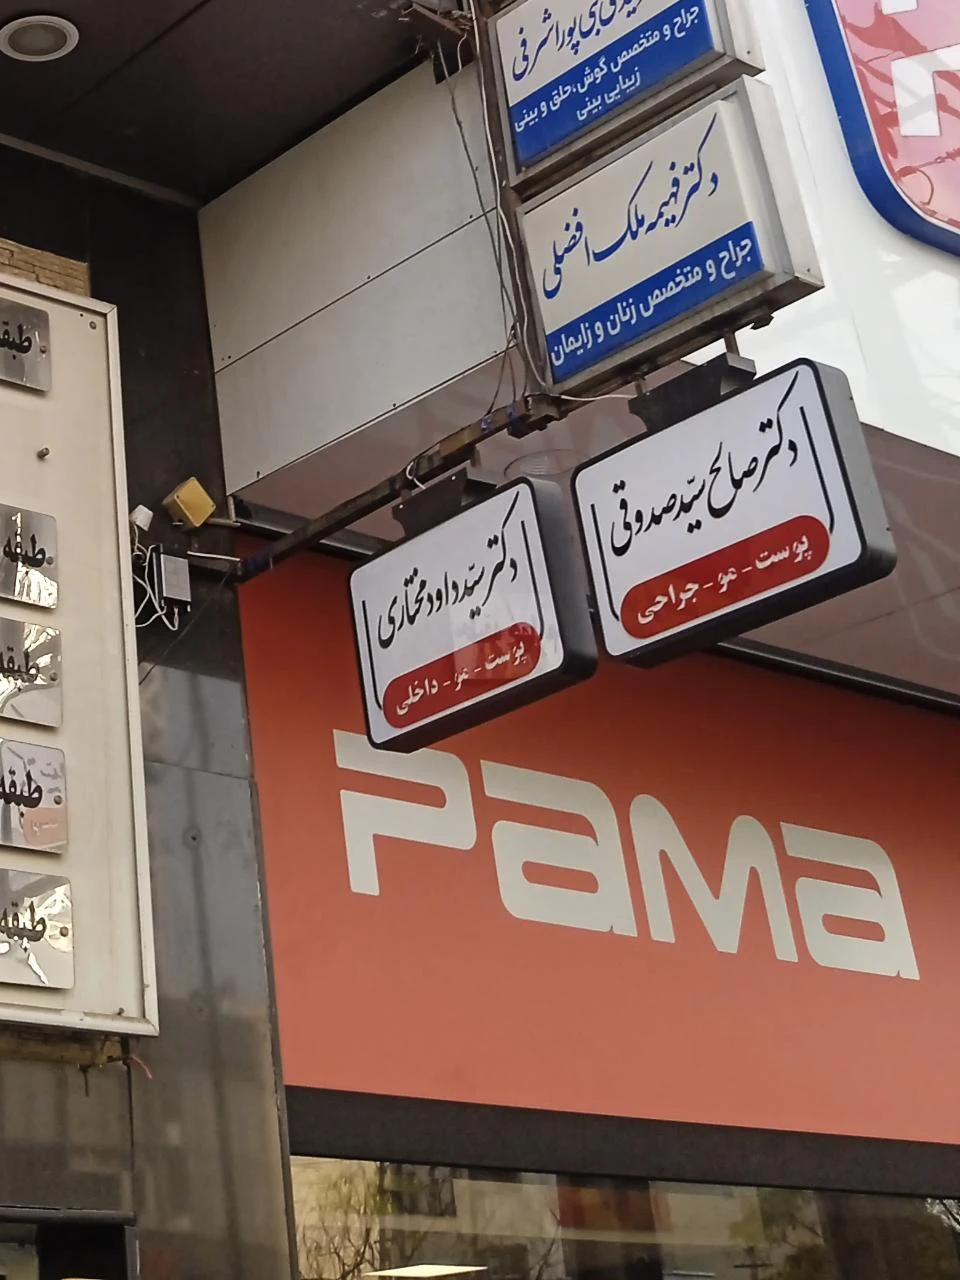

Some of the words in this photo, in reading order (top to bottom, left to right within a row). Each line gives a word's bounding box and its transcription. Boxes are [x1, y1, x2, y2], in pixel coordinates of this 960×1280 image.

[663, 24, 671, 41] و
[673, 4, 699, 38] جراح
[512, 8, 561, 82] اشرفی
[610, 30, 660, 72] متخصص
[576, 94, 602, 121] بینی
[604, 68, 642, 104] زیبایی
[514, 106, 539, 133] بینی
[675, 111, 720, 228] دکتر
[592, 160, 654, 262] ملک
[644, 161, 681, 235] فهیمه
[542, 207, 591, 300] افضلی
[706, 259, 716, 282] و
[719, 236, 753, 280] جراح
[639, 265, 703, 317] متخصص
[594, 321, 604, 343] و
[607, 298, 637, 336] زنان
[551, 323, 593, 367] زایمان
[752, 370, 800, 493] دکتر
[707, 441, 759, 519] صالح
[610, 479, 677, 557] صدوقی
[2, 525, 47, 569] طبقه
[482, 490, 520, 607] دکتر
[755, 534, 813, 570] پوست
[637, 580, 700, 625] جراحی
[717, 567, 737, 594] مو
[377, 567, 428, 649] مختاری
[484, 640, 528, 670] پوست
[396, 677, 439, 716] داخلی
